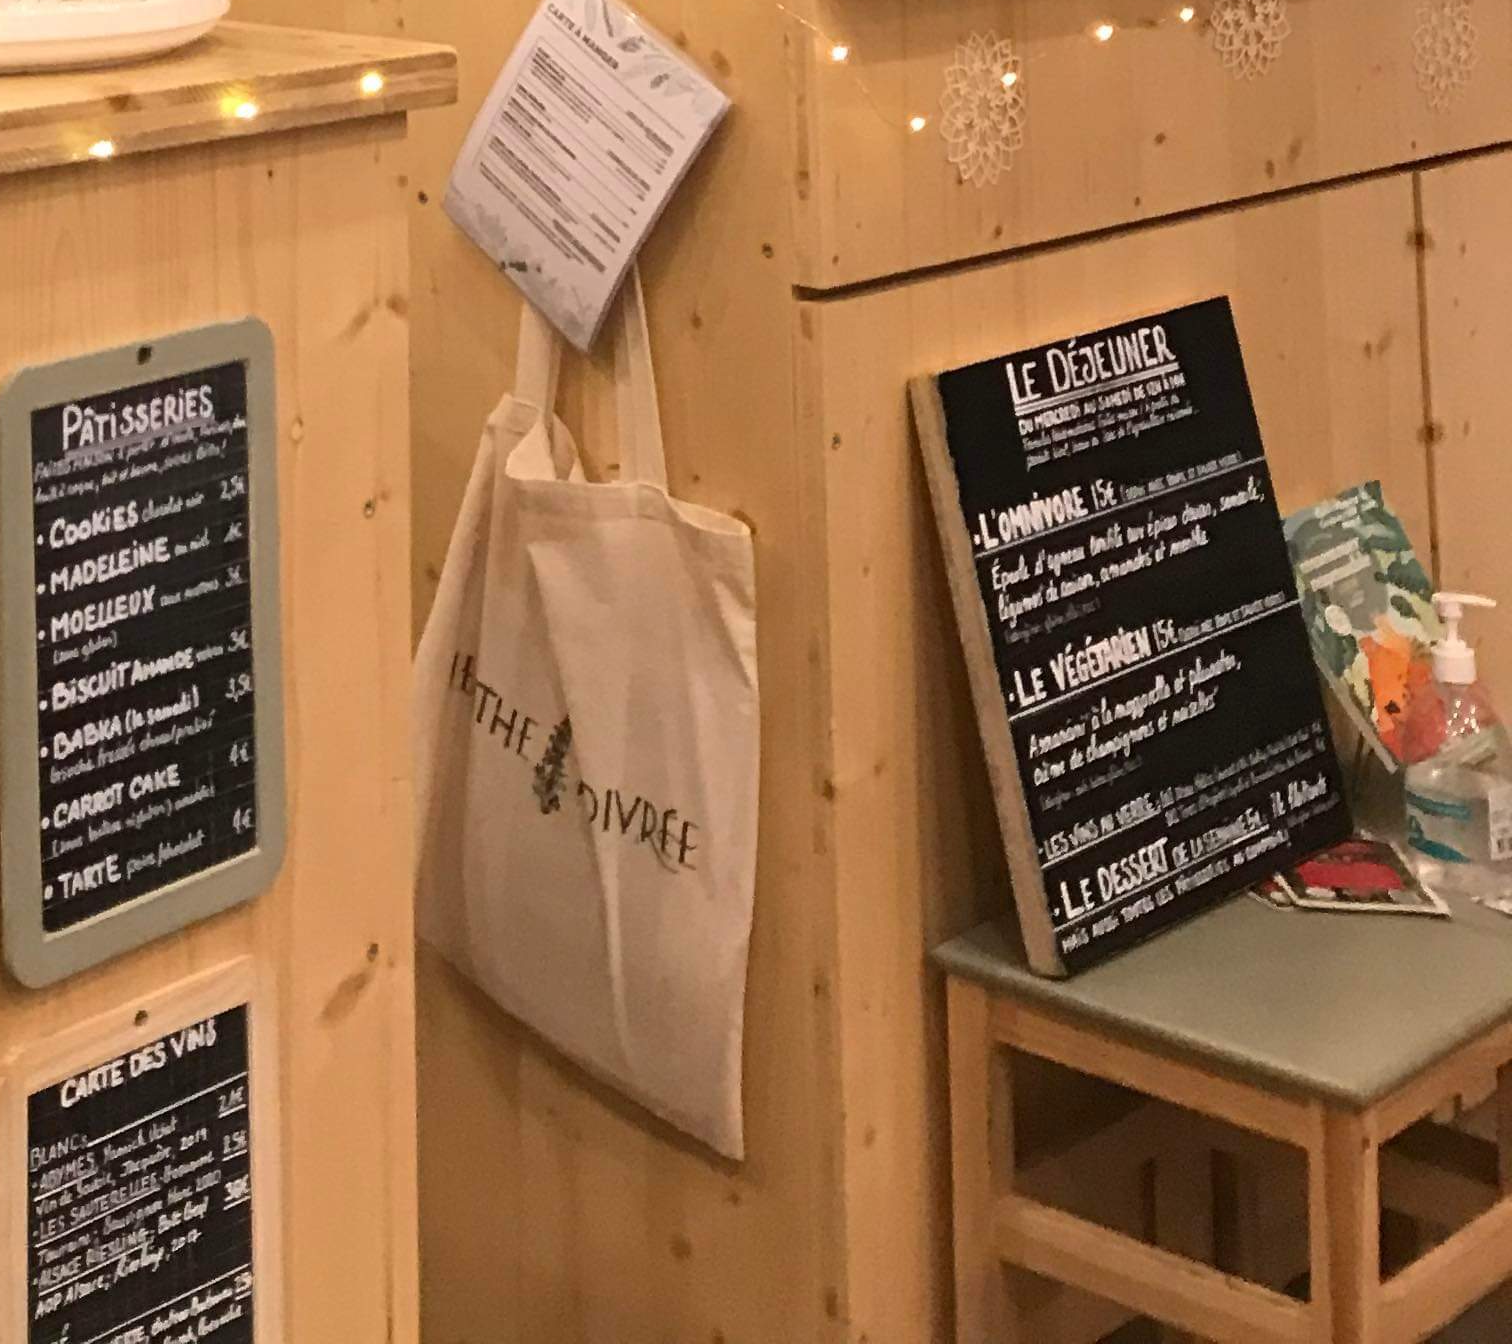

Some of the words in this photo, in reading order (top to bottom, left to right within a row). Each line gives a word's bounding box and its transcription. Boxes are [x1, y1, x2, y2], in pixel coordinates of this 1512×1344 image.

[547, 3, 575, 31] CARTE
[1006, 360, 1042, 404] LE
[1046, 324, 1177, 393] DÉJEUNER
[50, 501, 138, 548] COOKIES
[978, 485, 1088, 550] L'OMNIVORE
[1091, 478, 1117, 511] 15€
[51, 536, 171, 595] MADELEINE
[51, 585, 156, 642] MOELLEUX
[53, 661, 131, 711] BISCUIT
[1014, 667, 1048, 707] LE
[1049, 626, 1152, 691] VÉGÉTARIEN
[1152, 618, 1178, 652] 15€
[54, 714, 122, 760] BABKA
[54, 783, 124, 829] CARROT
[129, 763, 181, 800] CAKE
[58, 853, 121, 899] TARTE
[1060, 878, 1096, 920] LE
[1097, 837, 1168, 902] DESSERT
[60, 1059, 125, 1108] CARTE
[129, 1041, 167, 1078] DES
[170, 1018, 217, 1058] VINS
[40, 1215, 65, 1239] LES
